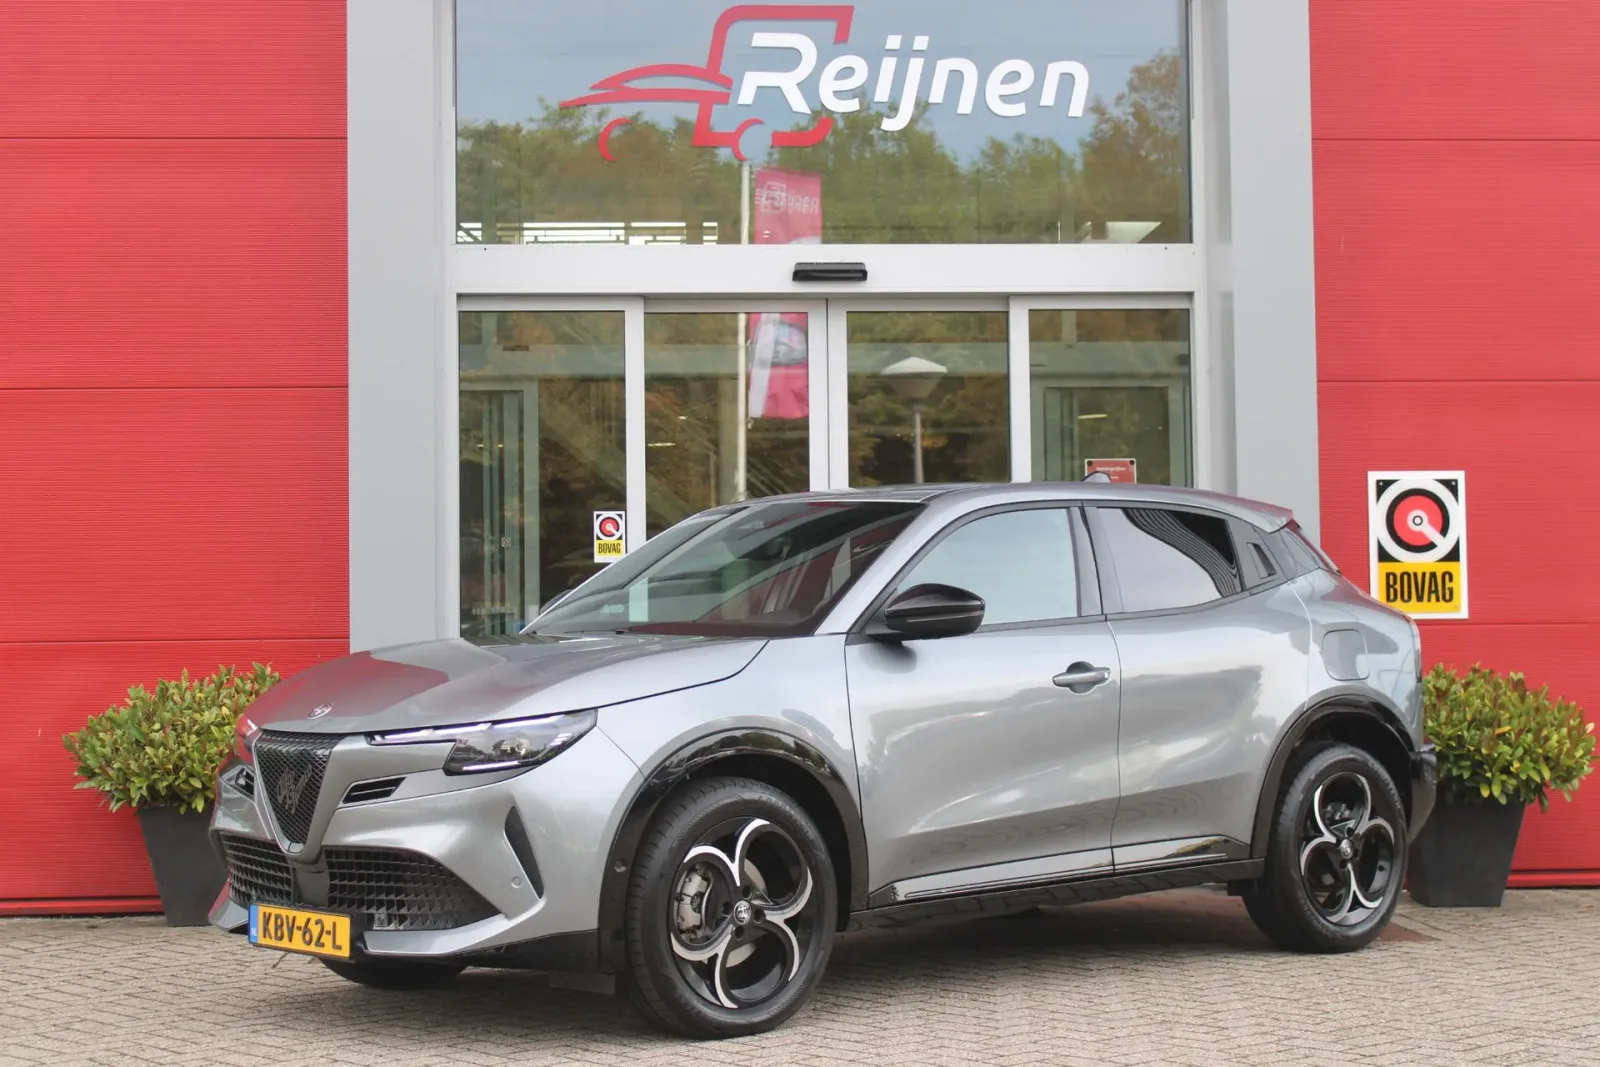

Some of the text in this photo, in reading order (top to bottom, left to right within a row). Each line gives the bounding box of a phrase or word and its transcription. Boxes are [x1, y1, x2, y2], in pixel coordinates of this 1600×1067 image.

[737, 32, 1091, 132] Reijnen
[598, 542, 621, 554] BOVAG
[1385, 571, 1454, 603] BOVAG
[262, 911, 343, 951] KBV-62-L
